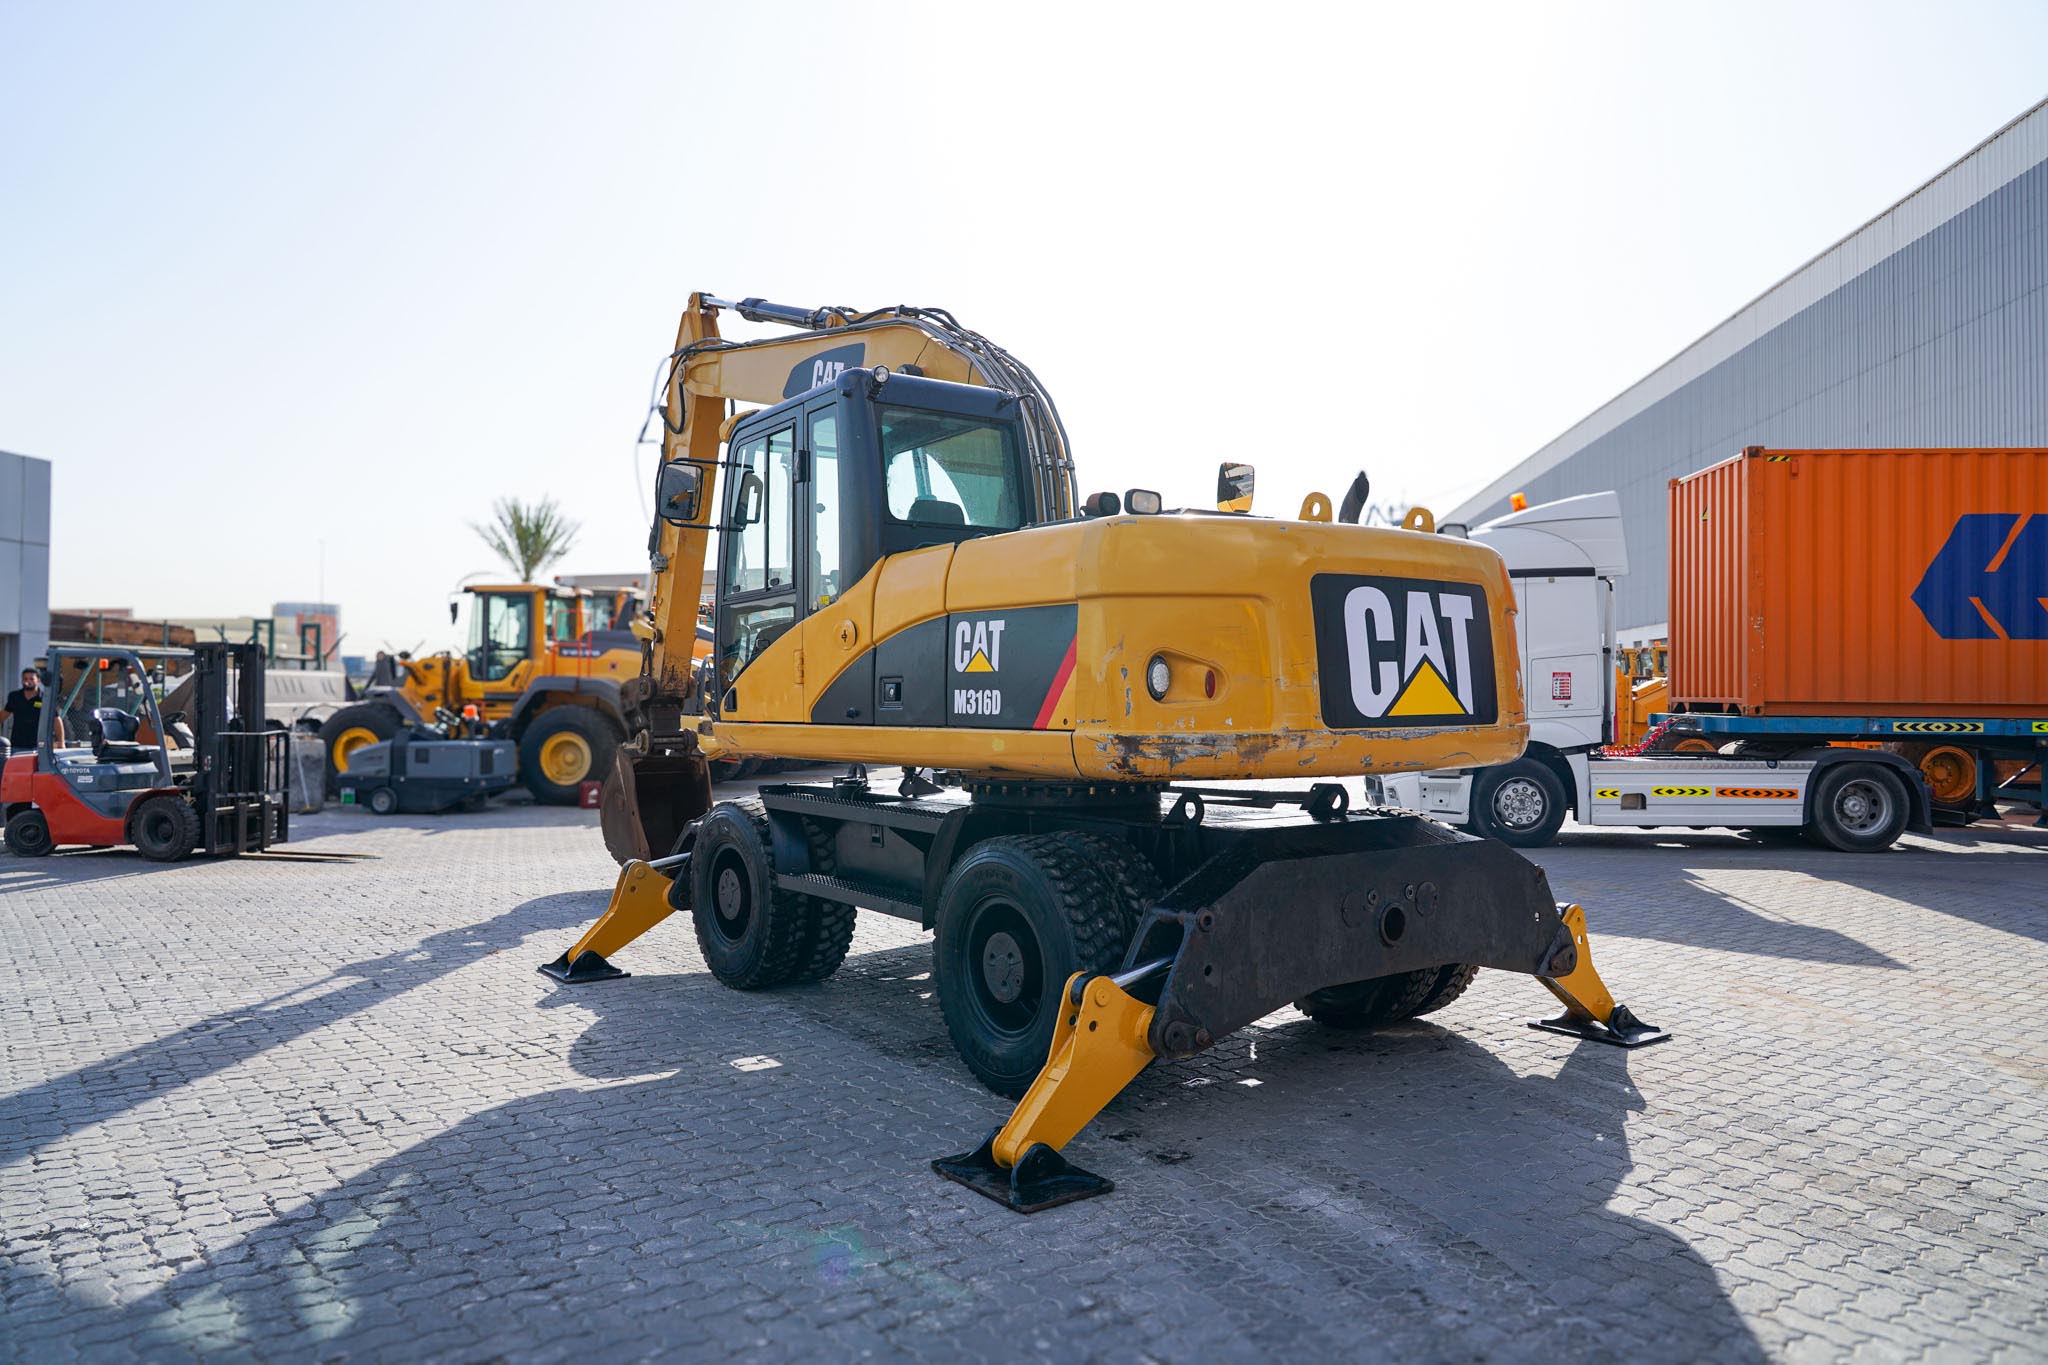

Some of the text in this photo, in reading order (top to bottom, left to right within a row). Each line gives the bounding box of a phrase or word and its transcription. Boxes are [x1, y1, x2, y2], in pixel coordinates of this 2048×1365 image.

[812, 360, 844, 389] CAT
[954, 619, 1005, 672] CAT
[1344, 586, 1474, 718] CAT
[954, 689, 1001, 715] M316D
